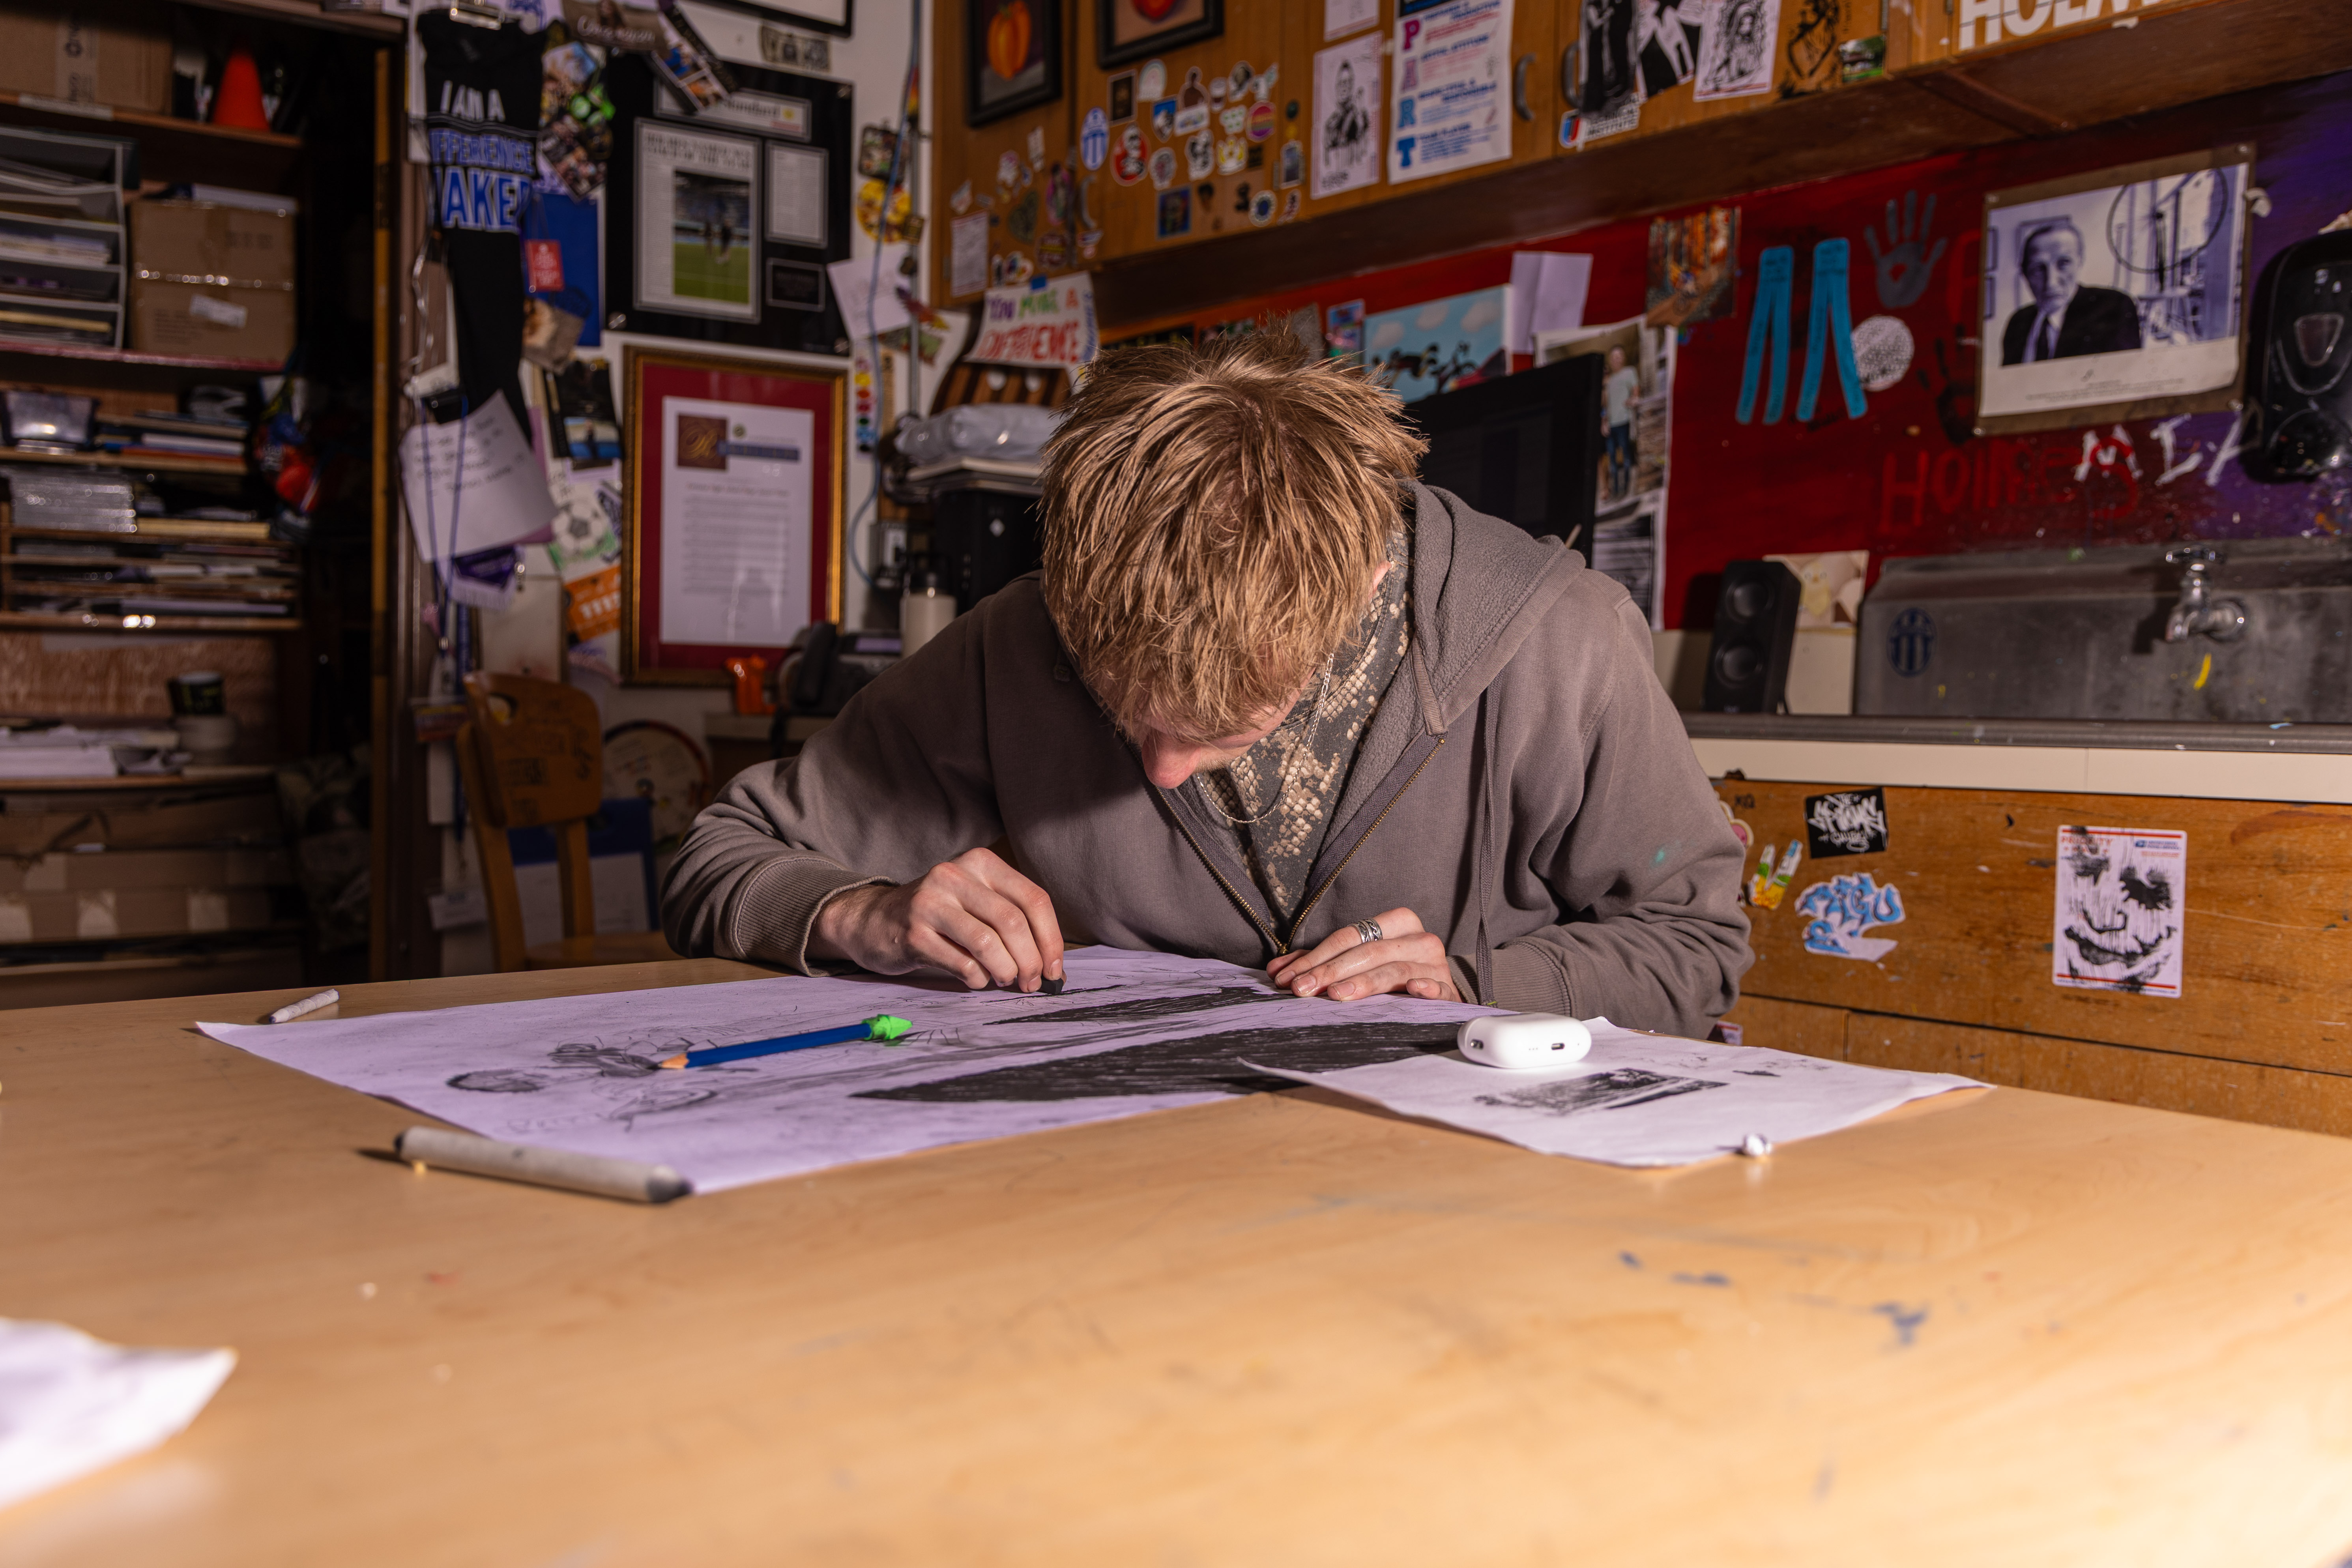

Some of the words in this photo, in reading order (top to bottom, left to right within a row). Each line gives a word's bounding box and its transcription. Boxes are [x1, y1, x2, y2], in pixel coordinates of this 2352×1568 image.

[1402, 19, 1420, 52] P
[1959, 0, 2164, 50] HOL
[440, 80, 453, 114] I
[451, 84, 485, 123] AM
[488, 89, 506, 122] A
[1396, 137, 1416, 169] T
